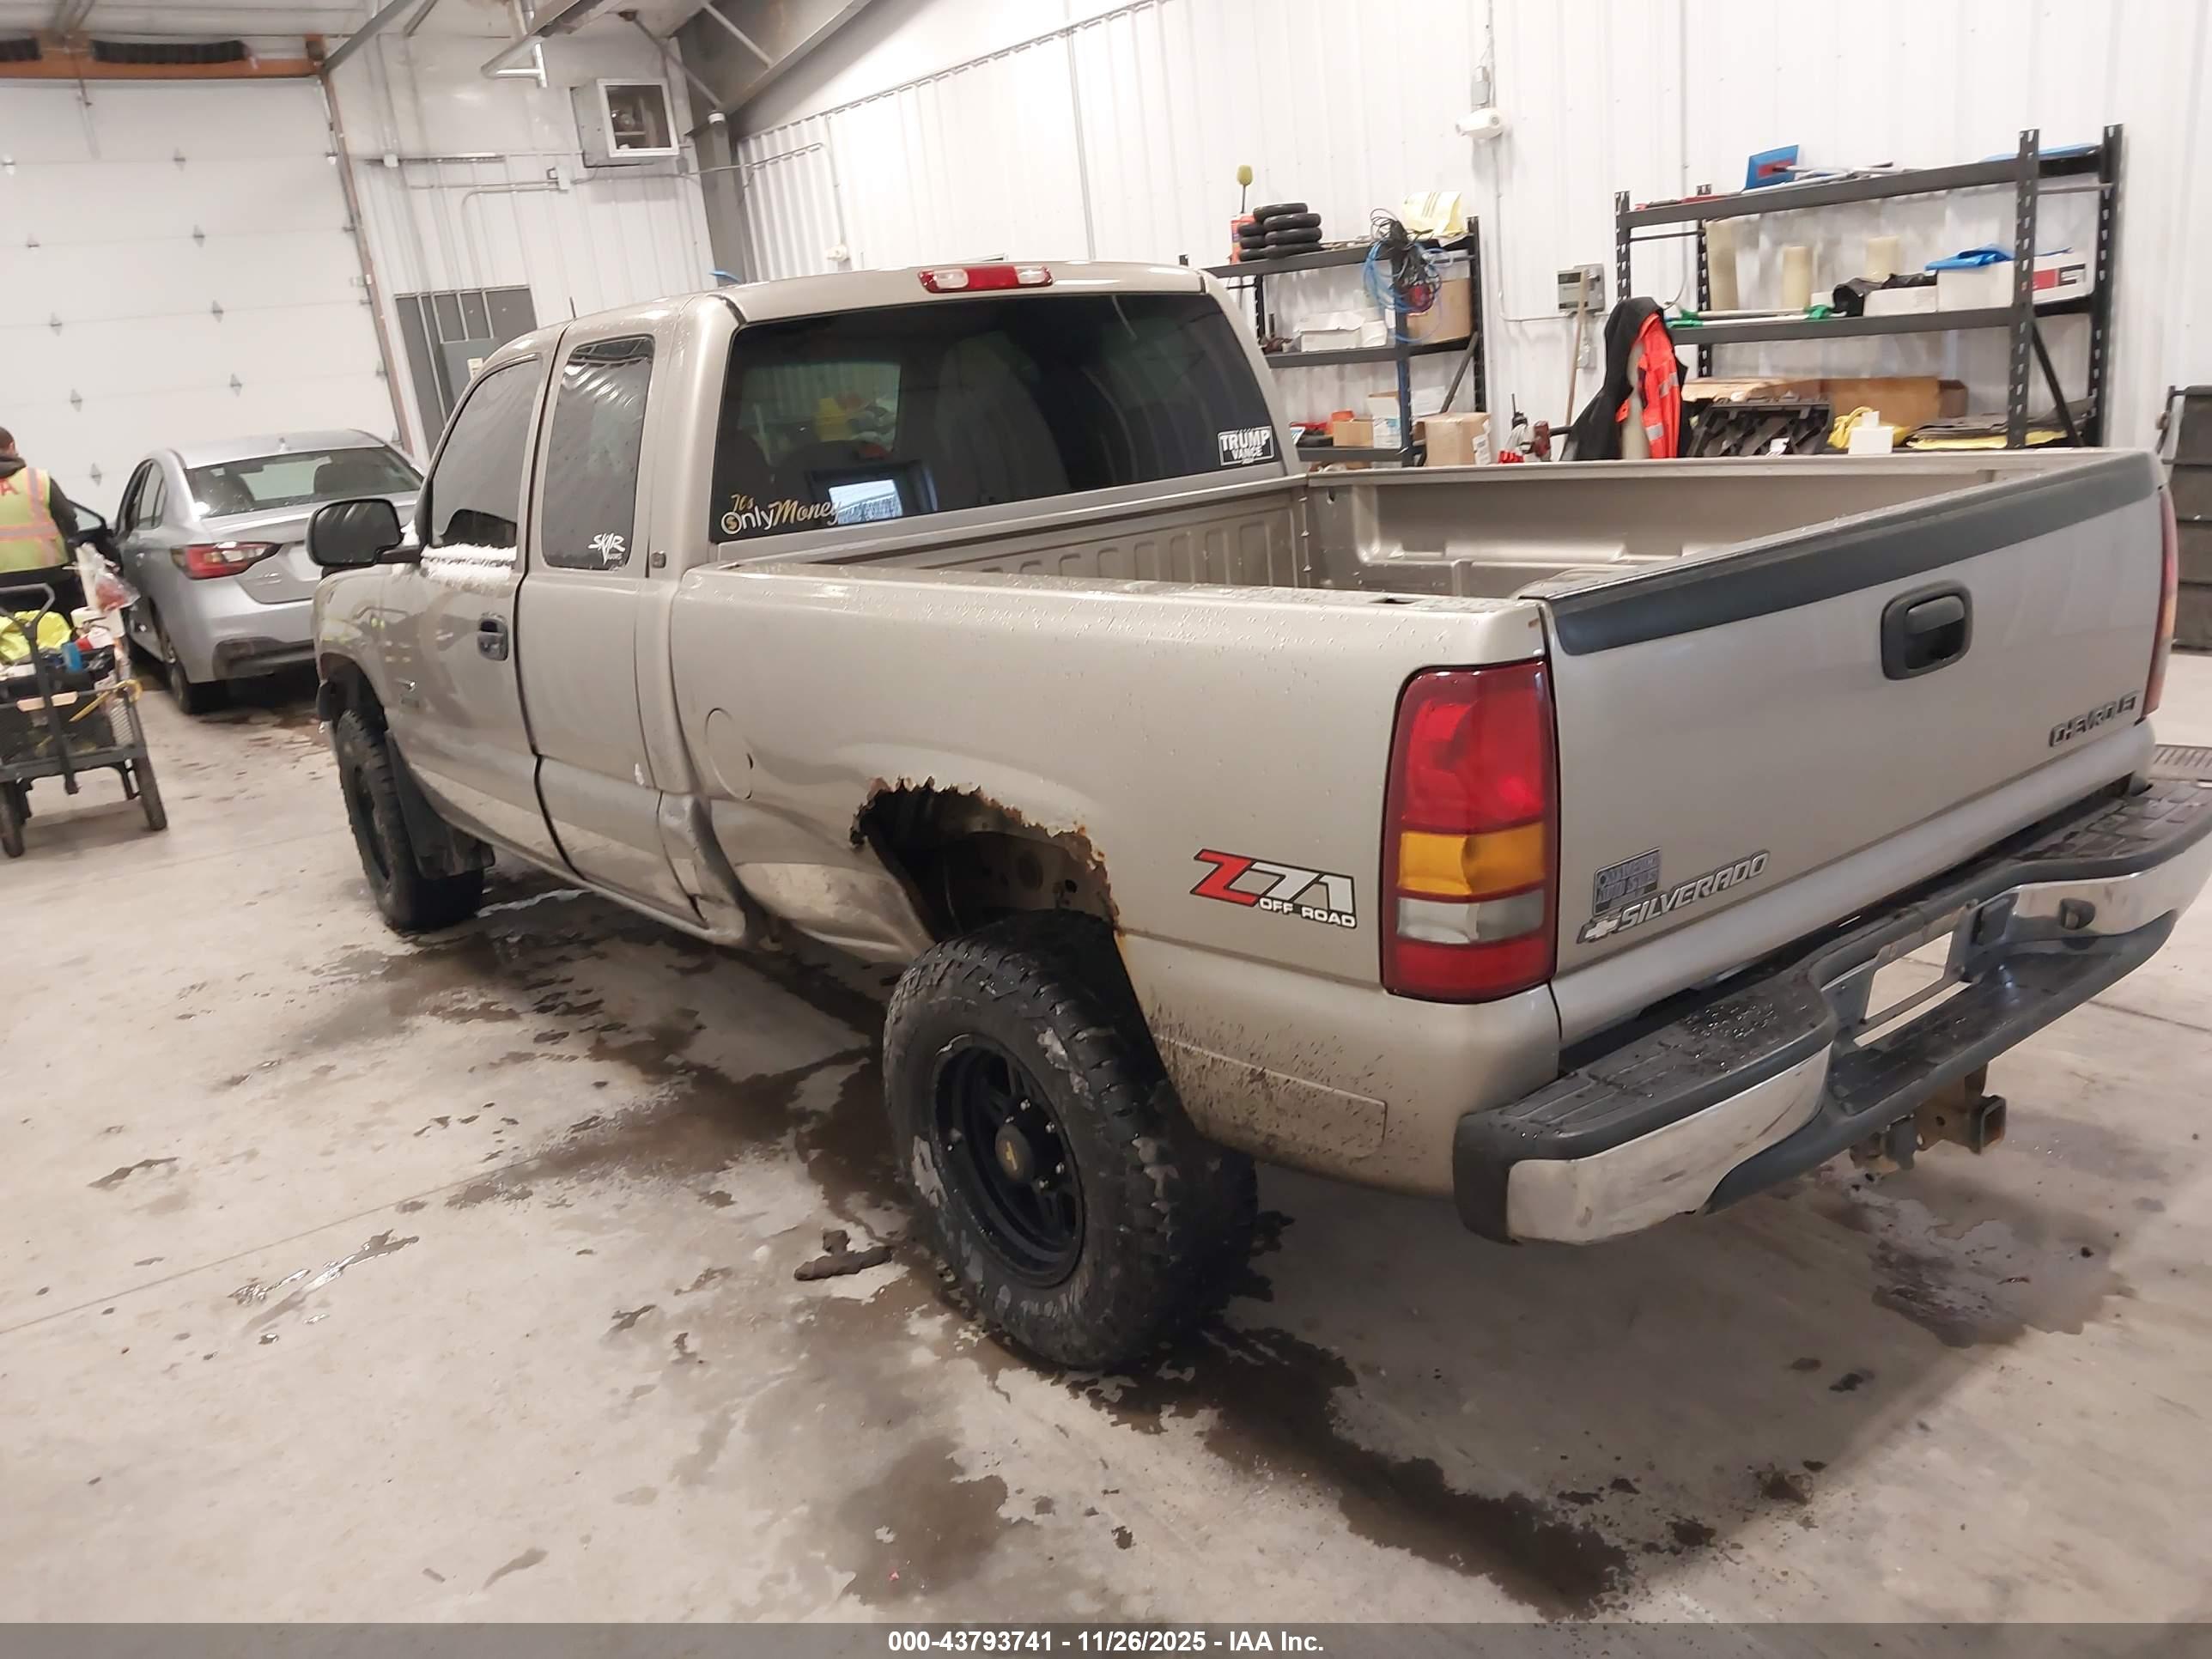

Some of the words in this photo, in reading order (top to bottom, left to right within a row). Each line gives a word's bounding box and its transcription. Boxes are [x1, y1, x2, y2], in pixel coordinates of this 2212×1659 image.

[1219, 430, 1271, 452] TRUMP
[1231, 447, 1263, 460] VANCE
[1189, 848, 1355, 913] Z71
[1617, 853, 1770, 932] SILVERADO
[1260, 897, 1294, 914] OFF
[1302, 906, 1356, 928] ROAD
